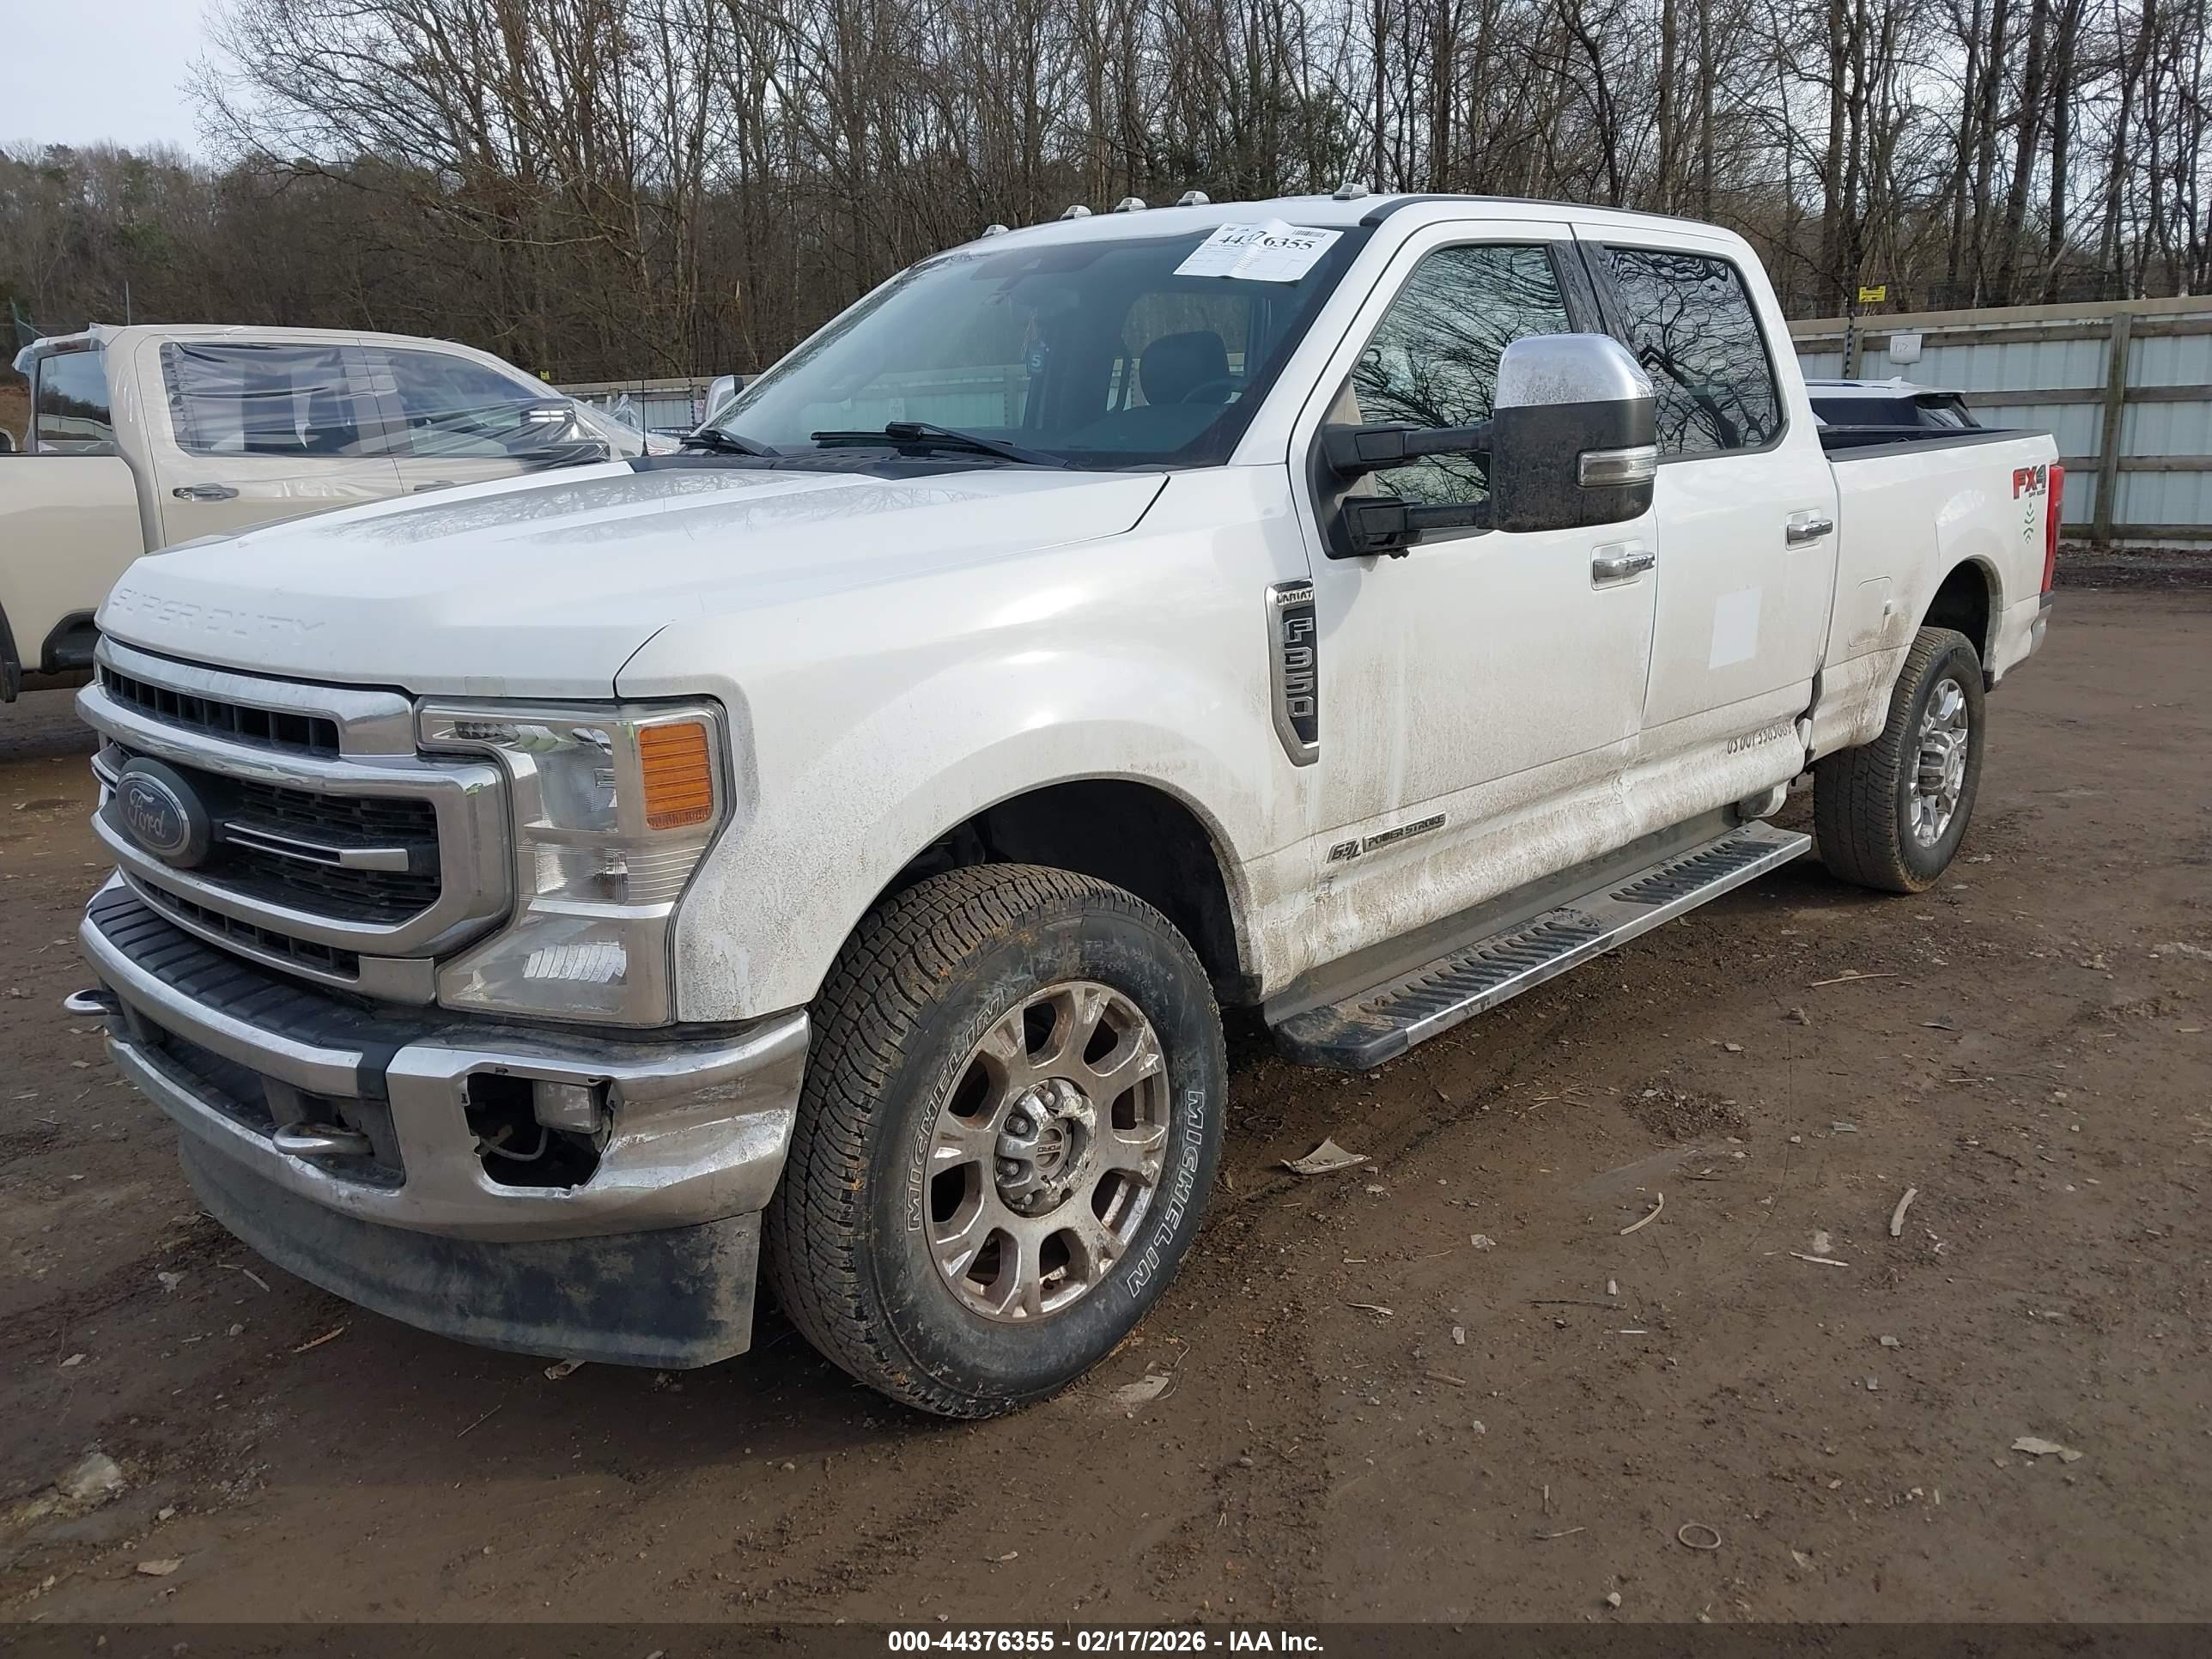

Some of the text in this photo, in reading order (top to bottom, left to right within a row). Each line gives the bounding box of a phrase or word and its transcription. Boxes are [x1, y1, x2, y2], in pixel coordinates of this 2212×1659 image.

[2013, 464, 2046, 500] FX4
[112, 588, 326, 641] SUPER DUTY
[1277, 589, 1313, 605] LARIAT
[1284, 617, 1314, 718] F350
[128, 787, 167, 839] Ford
[1368, 828, 1404, 848] POWER
[1405, 816, 1445, 835] STROKE
[907, 994, 1002, 1231] MICHELIN
[1127, 1091, 1204, 1298] MICHELIN
